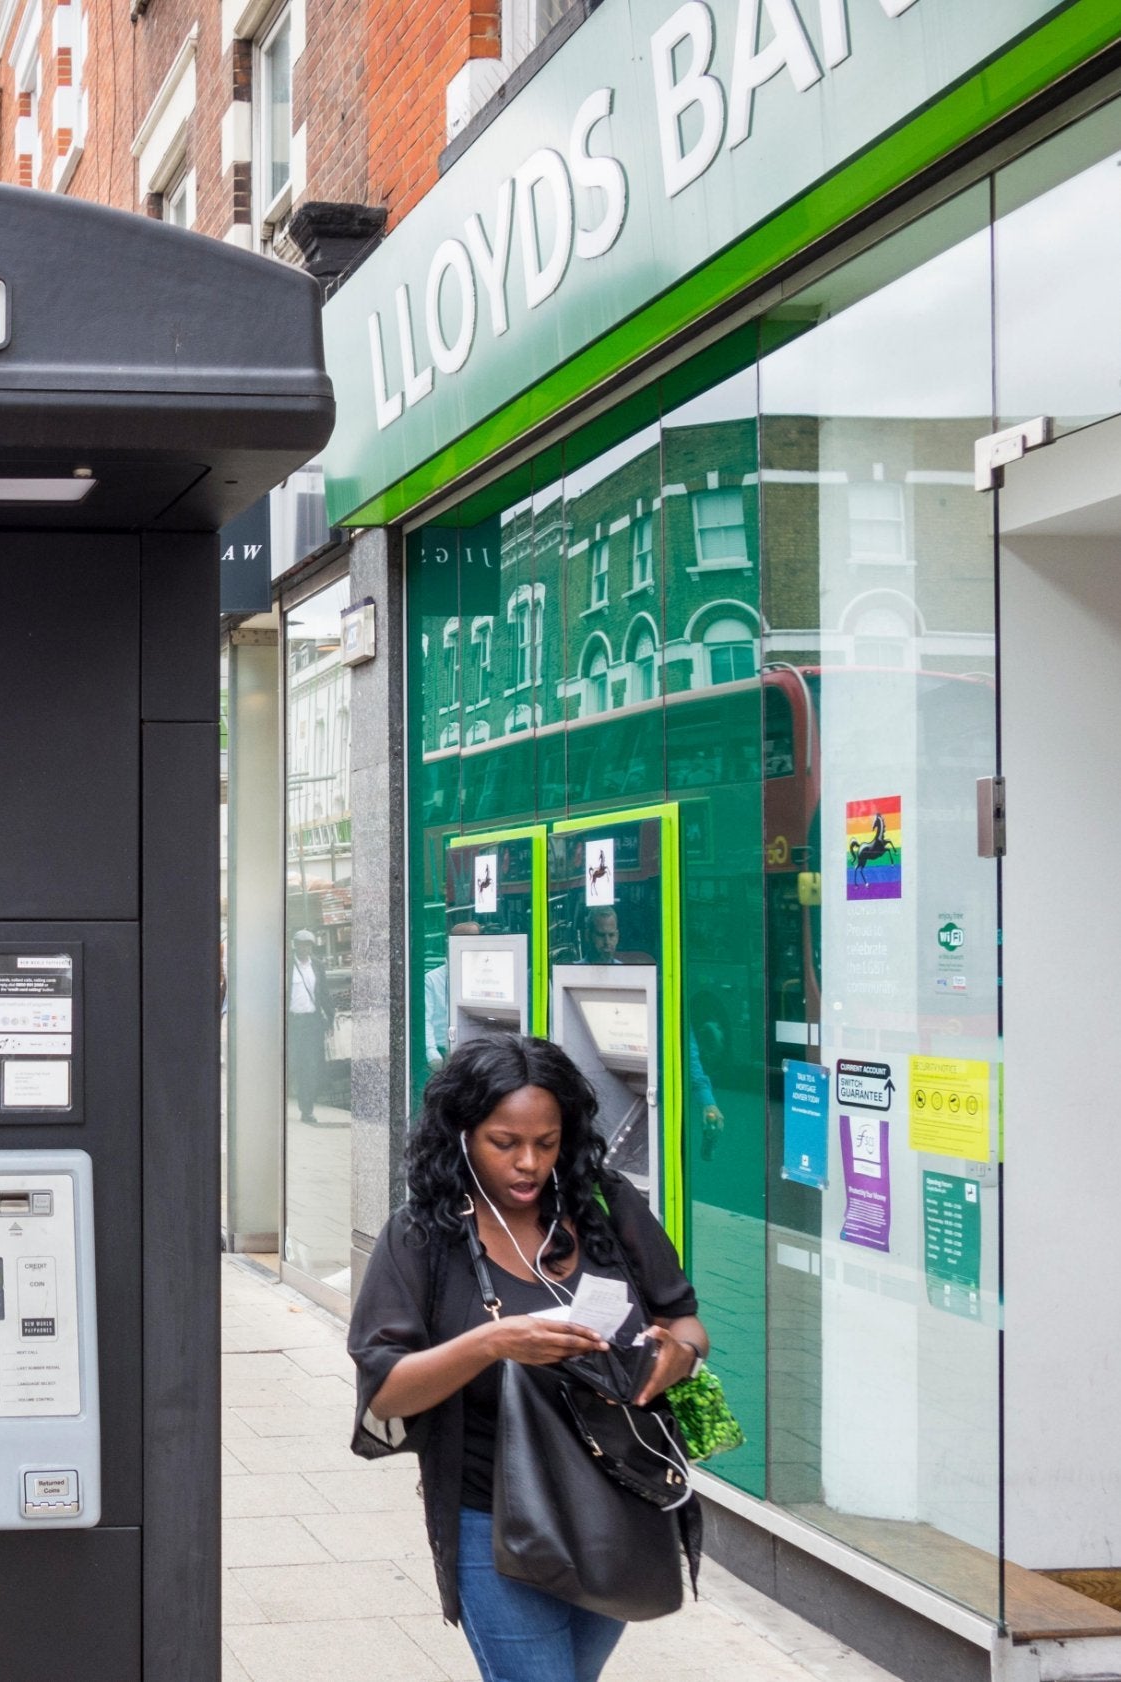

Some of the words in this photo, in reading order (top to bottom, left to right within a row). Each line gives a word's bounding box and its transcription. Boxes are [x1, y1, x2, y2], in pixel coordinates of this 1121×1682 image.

[368, 87, 628, 430] LLOYDS
[841, 1078, 863, 1088] SWITCH
[841, 1087, 883, 1102] GUARANTEE
